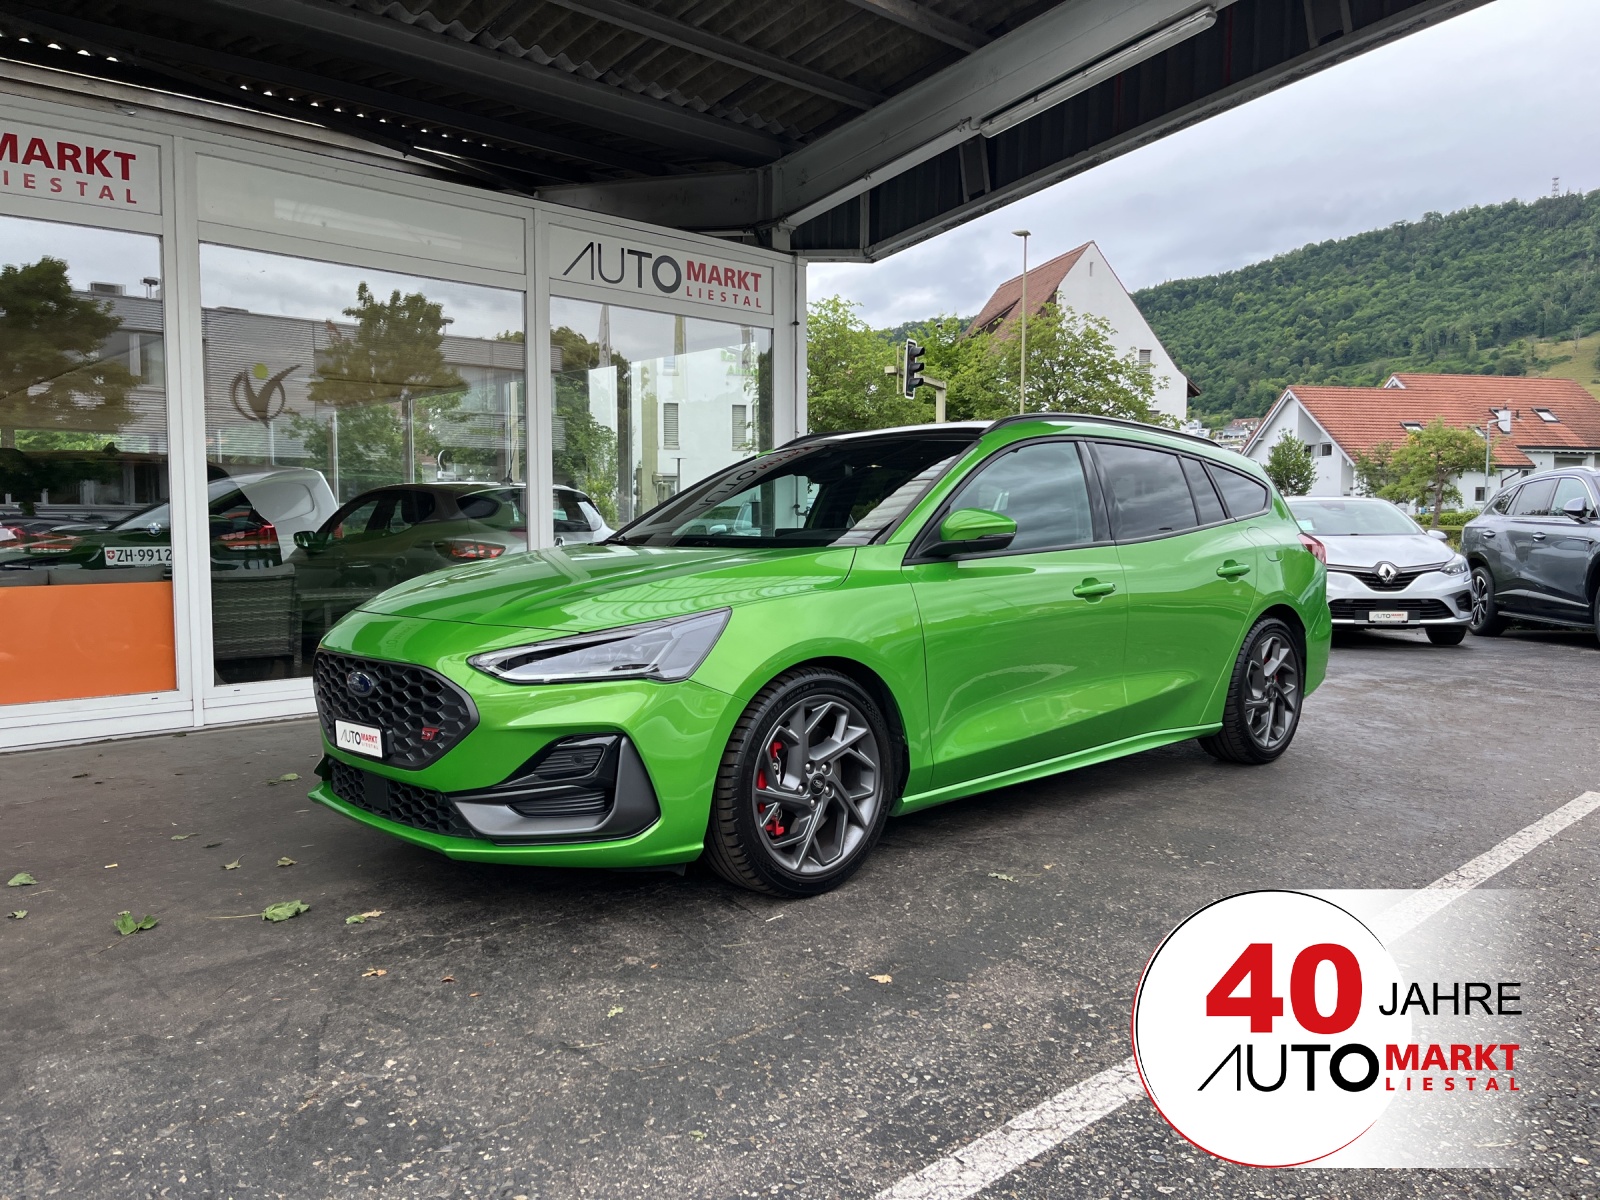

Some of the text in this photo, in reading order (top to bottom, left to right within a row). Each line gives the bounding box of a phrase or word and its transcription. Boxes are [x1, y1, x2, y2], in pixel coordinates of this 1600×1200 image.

[562, 241, 762, 294] AUTO MARKT
[686, 285, 762, 308] LIESTAL
[341, 729, 361, 745] AUTO
